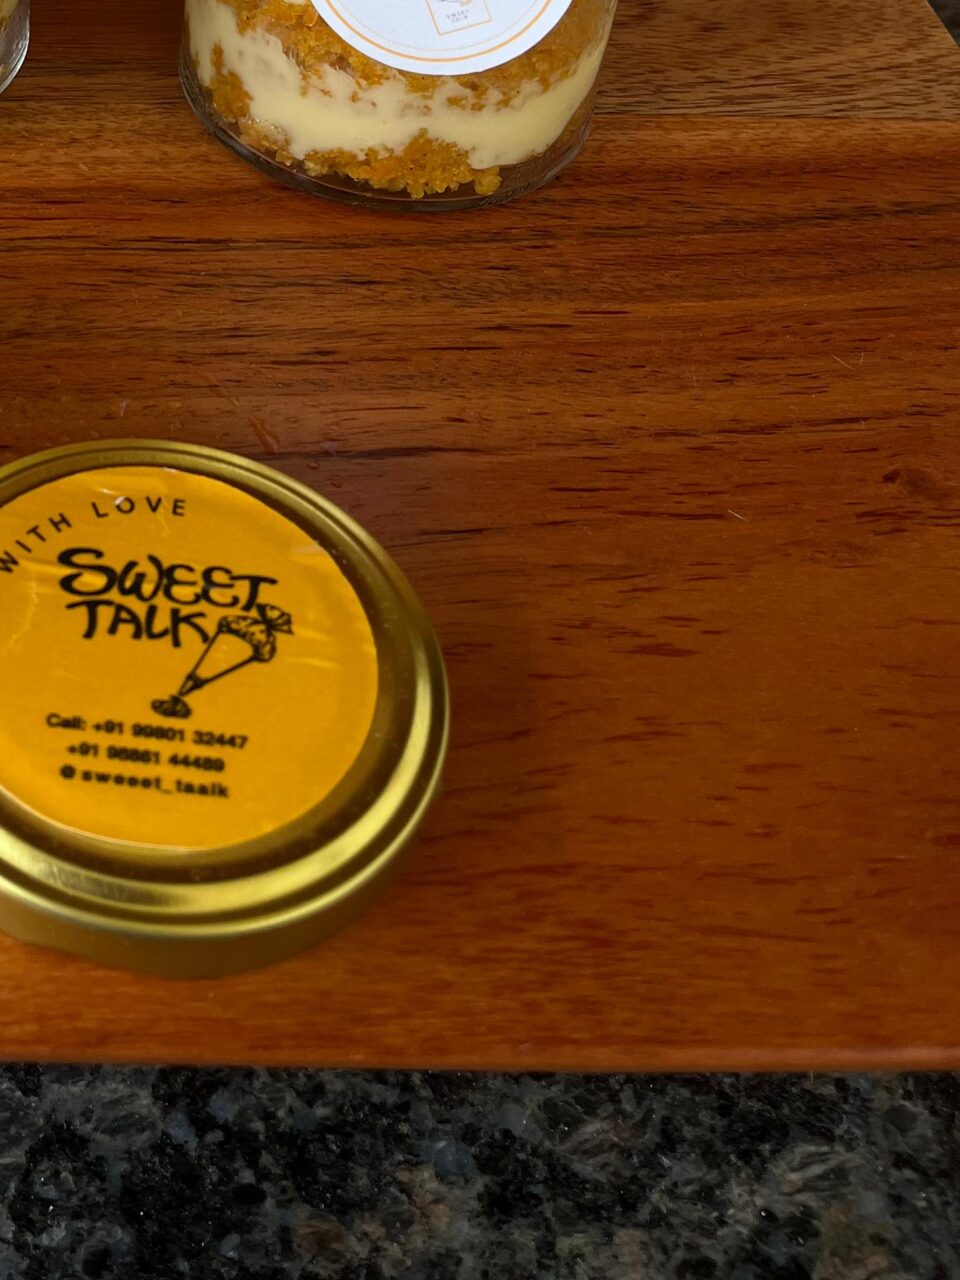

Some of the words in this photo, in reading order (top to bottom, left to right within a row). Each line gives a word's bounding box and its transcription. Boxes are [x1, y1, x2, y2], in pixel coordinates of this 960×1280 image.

[91, 495, 187, 519] LOVE
[57, 546, 278, 612] SWEET
[65, 599, 210, 647] TALK
[46, 713, 86, 731] Call:
[93, 720, 124, 735] +91
[67, 742, 99, 757] +91
